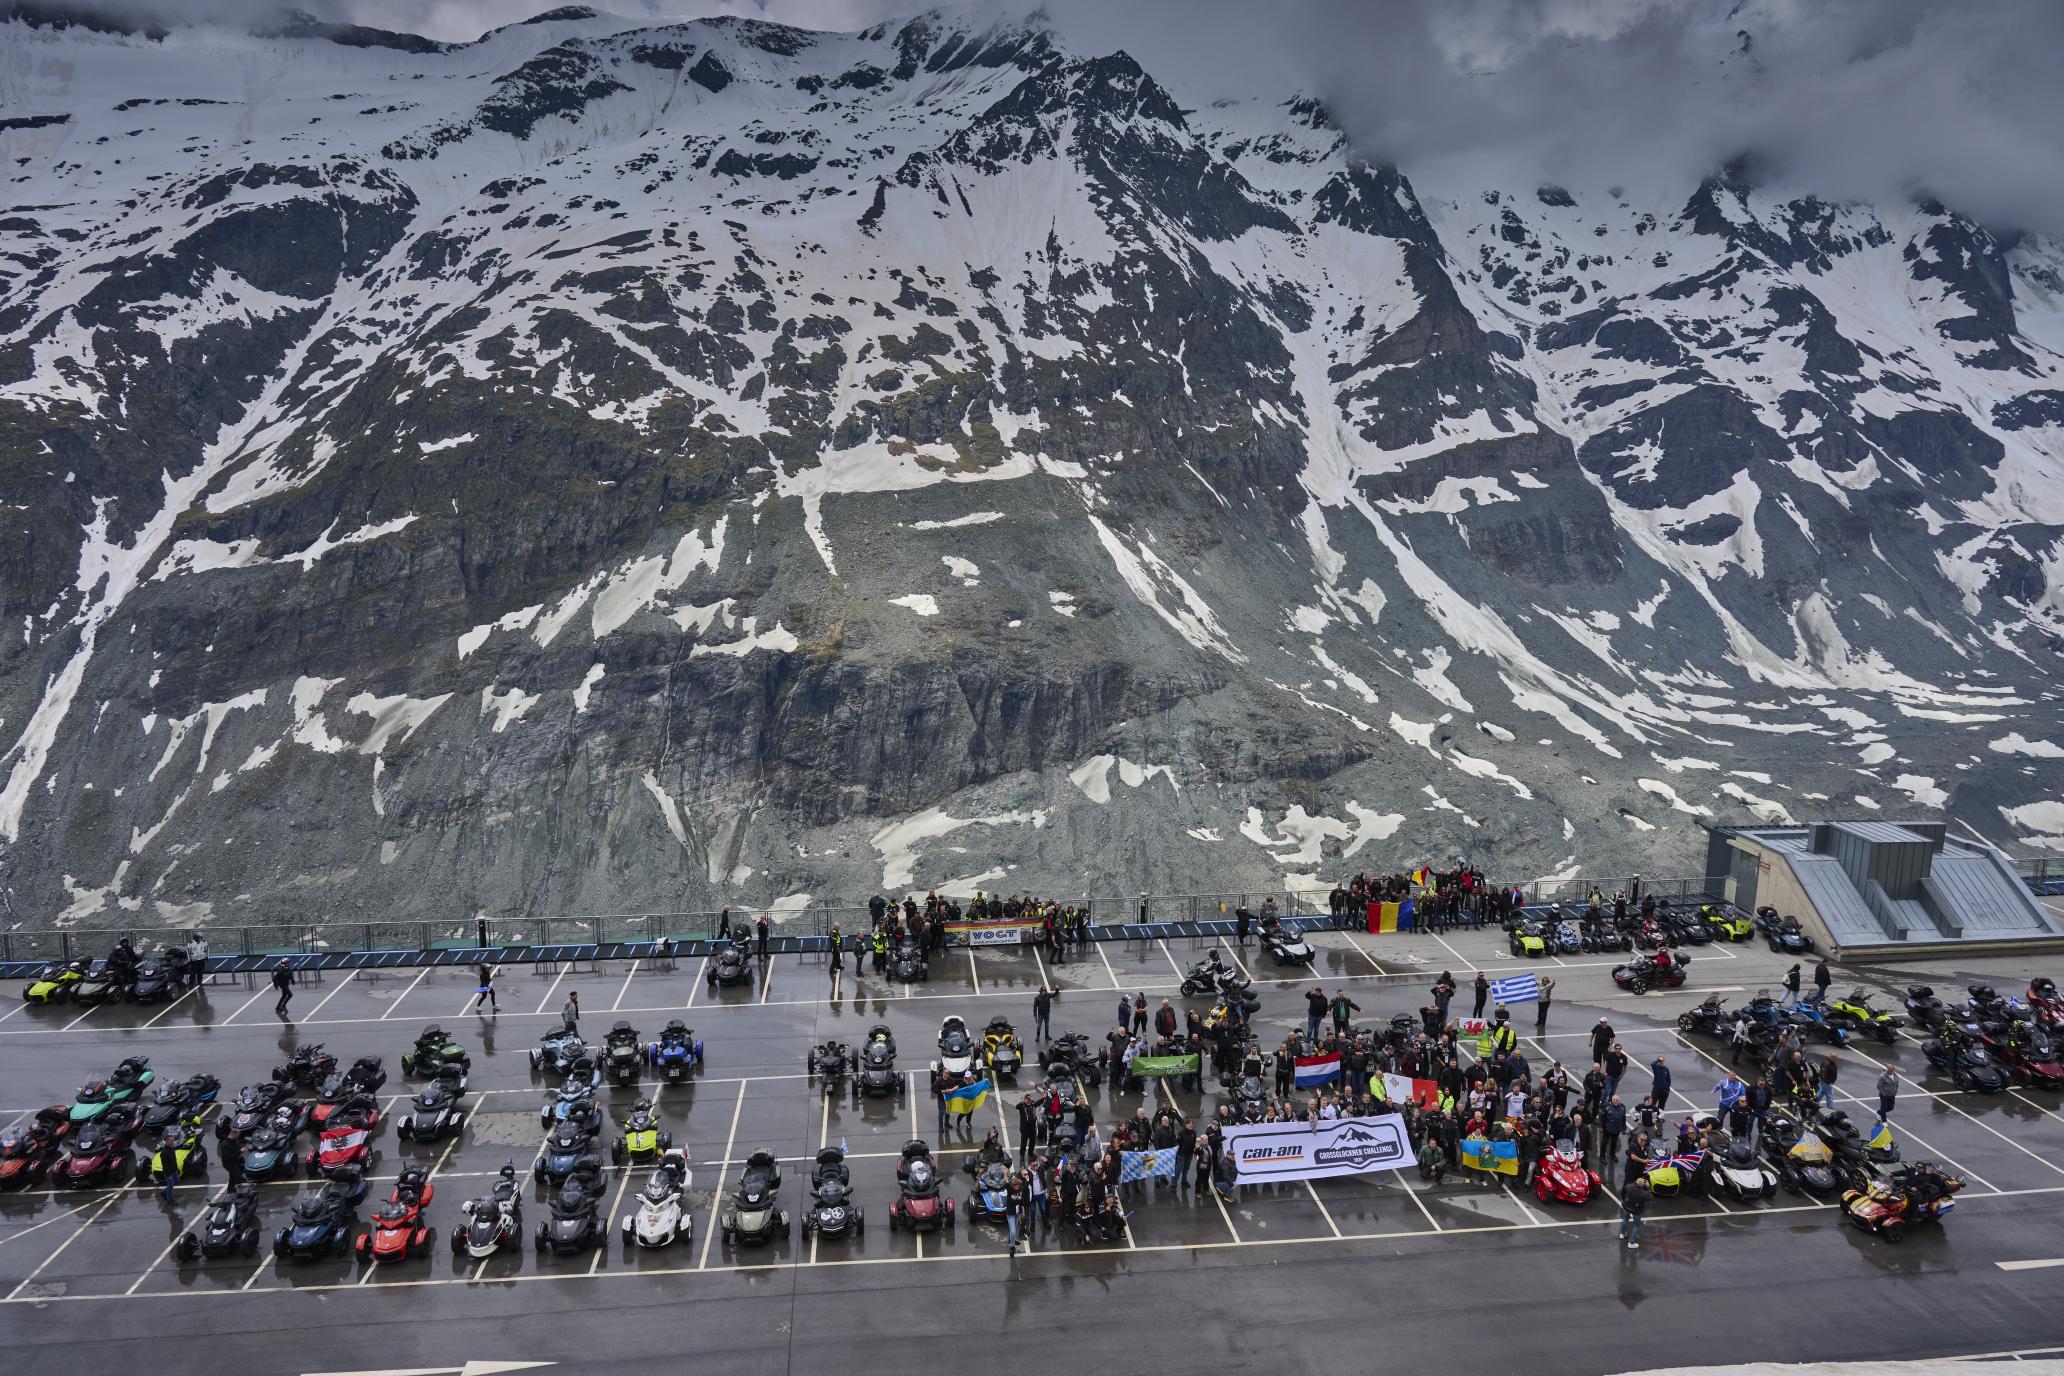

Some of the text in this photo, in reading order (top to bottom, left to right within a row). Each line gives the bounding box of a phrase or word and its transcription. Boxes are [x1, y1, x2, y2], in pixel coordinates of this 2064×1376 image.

[972, 929, 1017, 939] VOGT
[1242, 1145, 1303, 1159] can-am
[1319, 1145, 1394, 1160] GROSSGLOCKNER CHALLENGE
